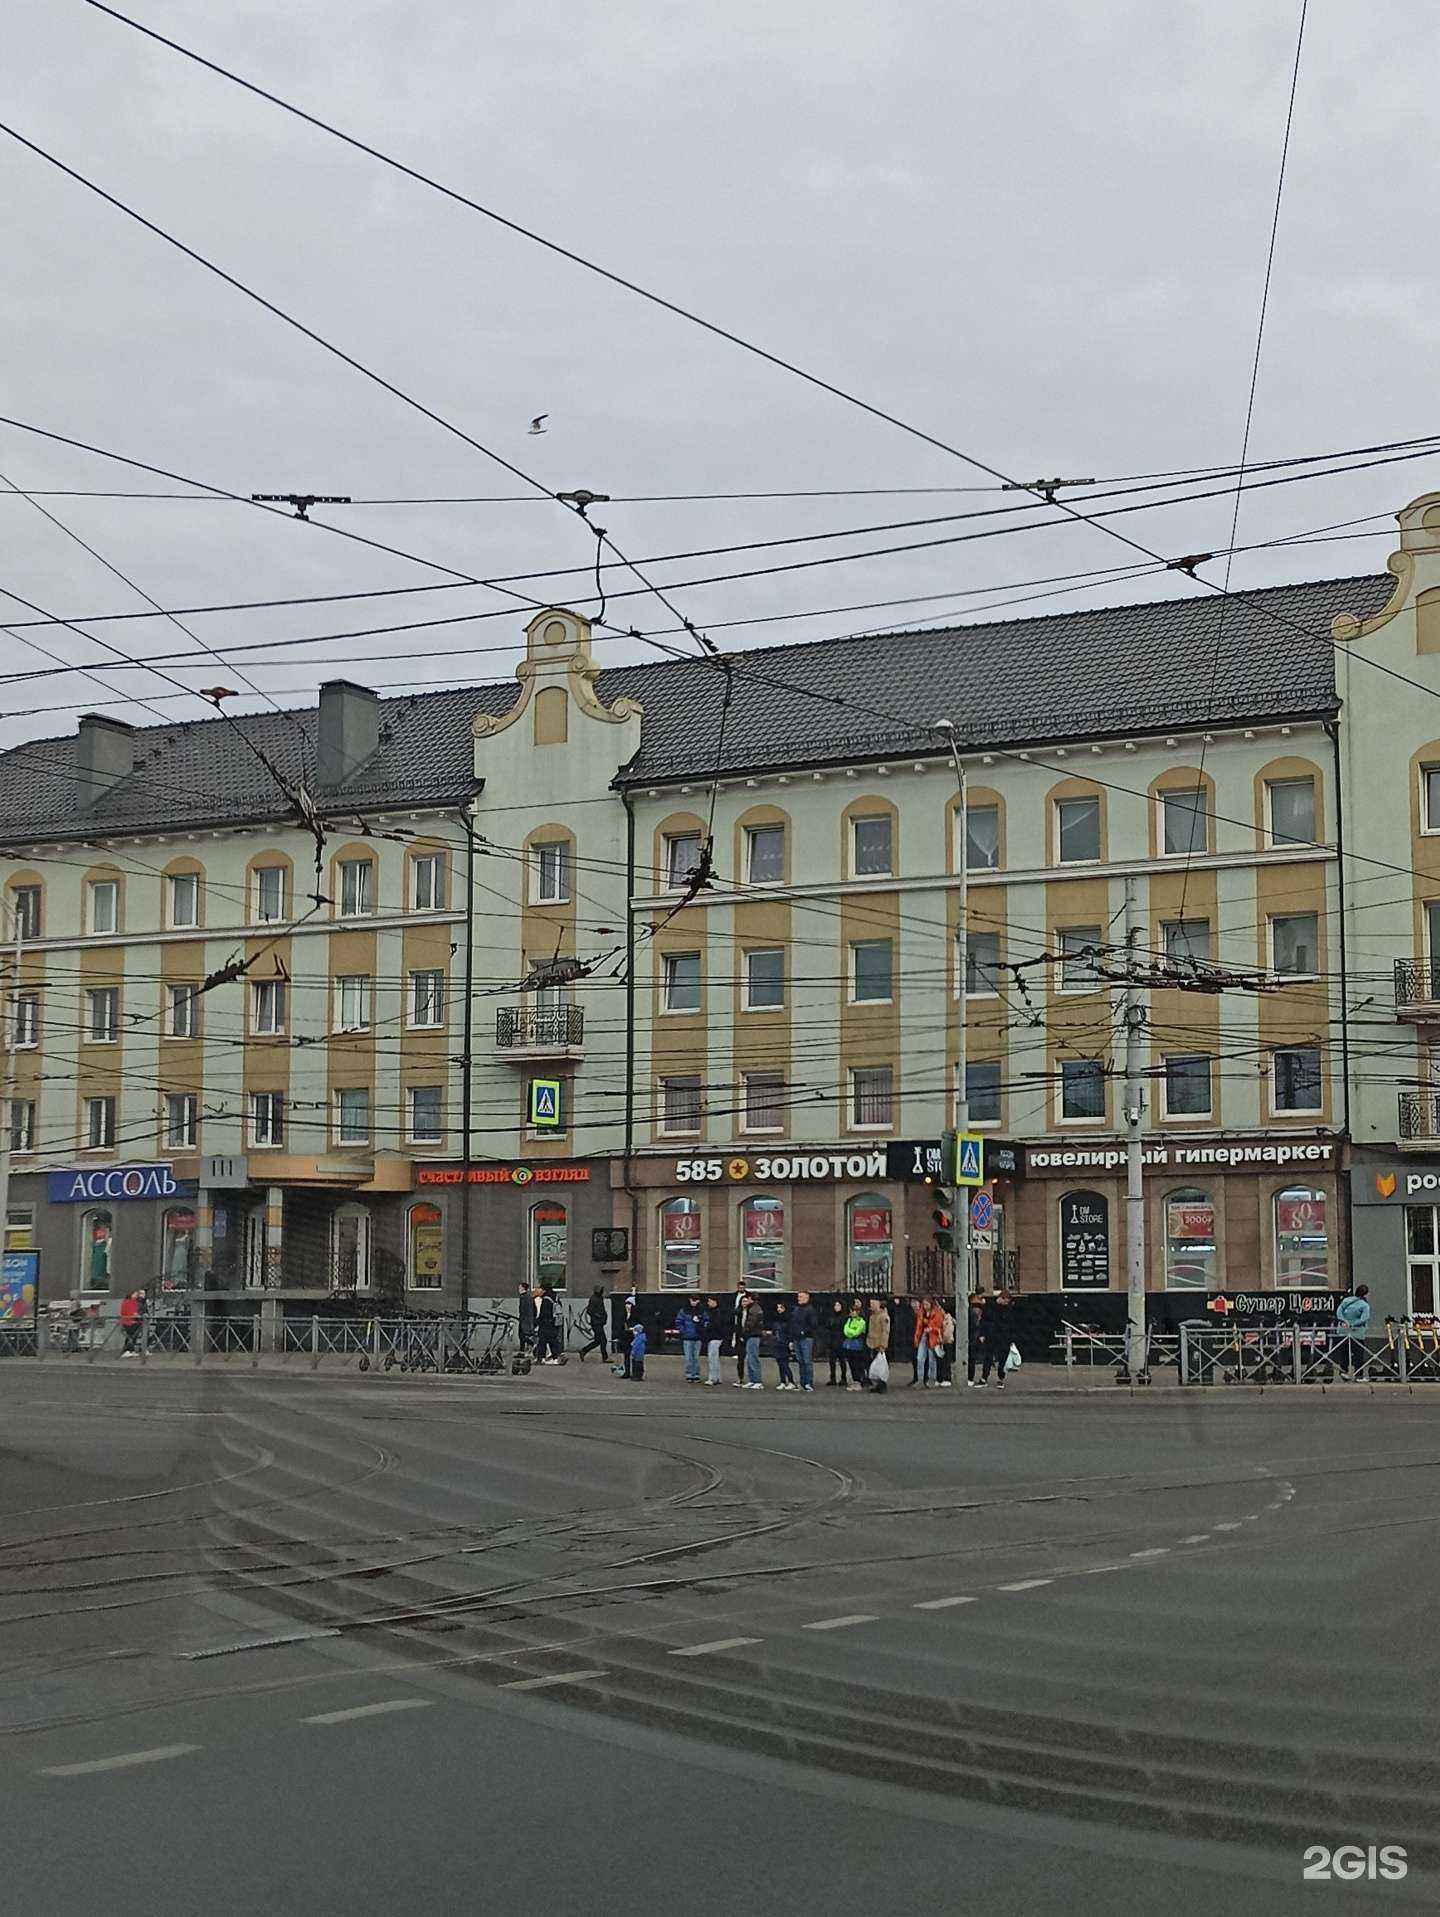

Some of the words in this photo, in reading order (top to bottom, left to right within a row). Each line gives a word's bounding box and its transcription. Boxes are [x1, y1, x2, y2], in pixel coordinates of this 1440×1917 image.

[676, 1159, 723, 1181] 585
[754, 1151, 888, 1180] ЗОЛОТОЙ
[1030, 1145, 1168, 1169] ювелирный
[1175, 1145, 1333, 1165] гипермаркет
[69, 1169, 177, 1198] АССОЛЬ
[1407, 1174, 1440, 1195] ро
[1235, 1293, 1286, 1315] Супер
[1288, 1294, 1335, 1315] Цены
